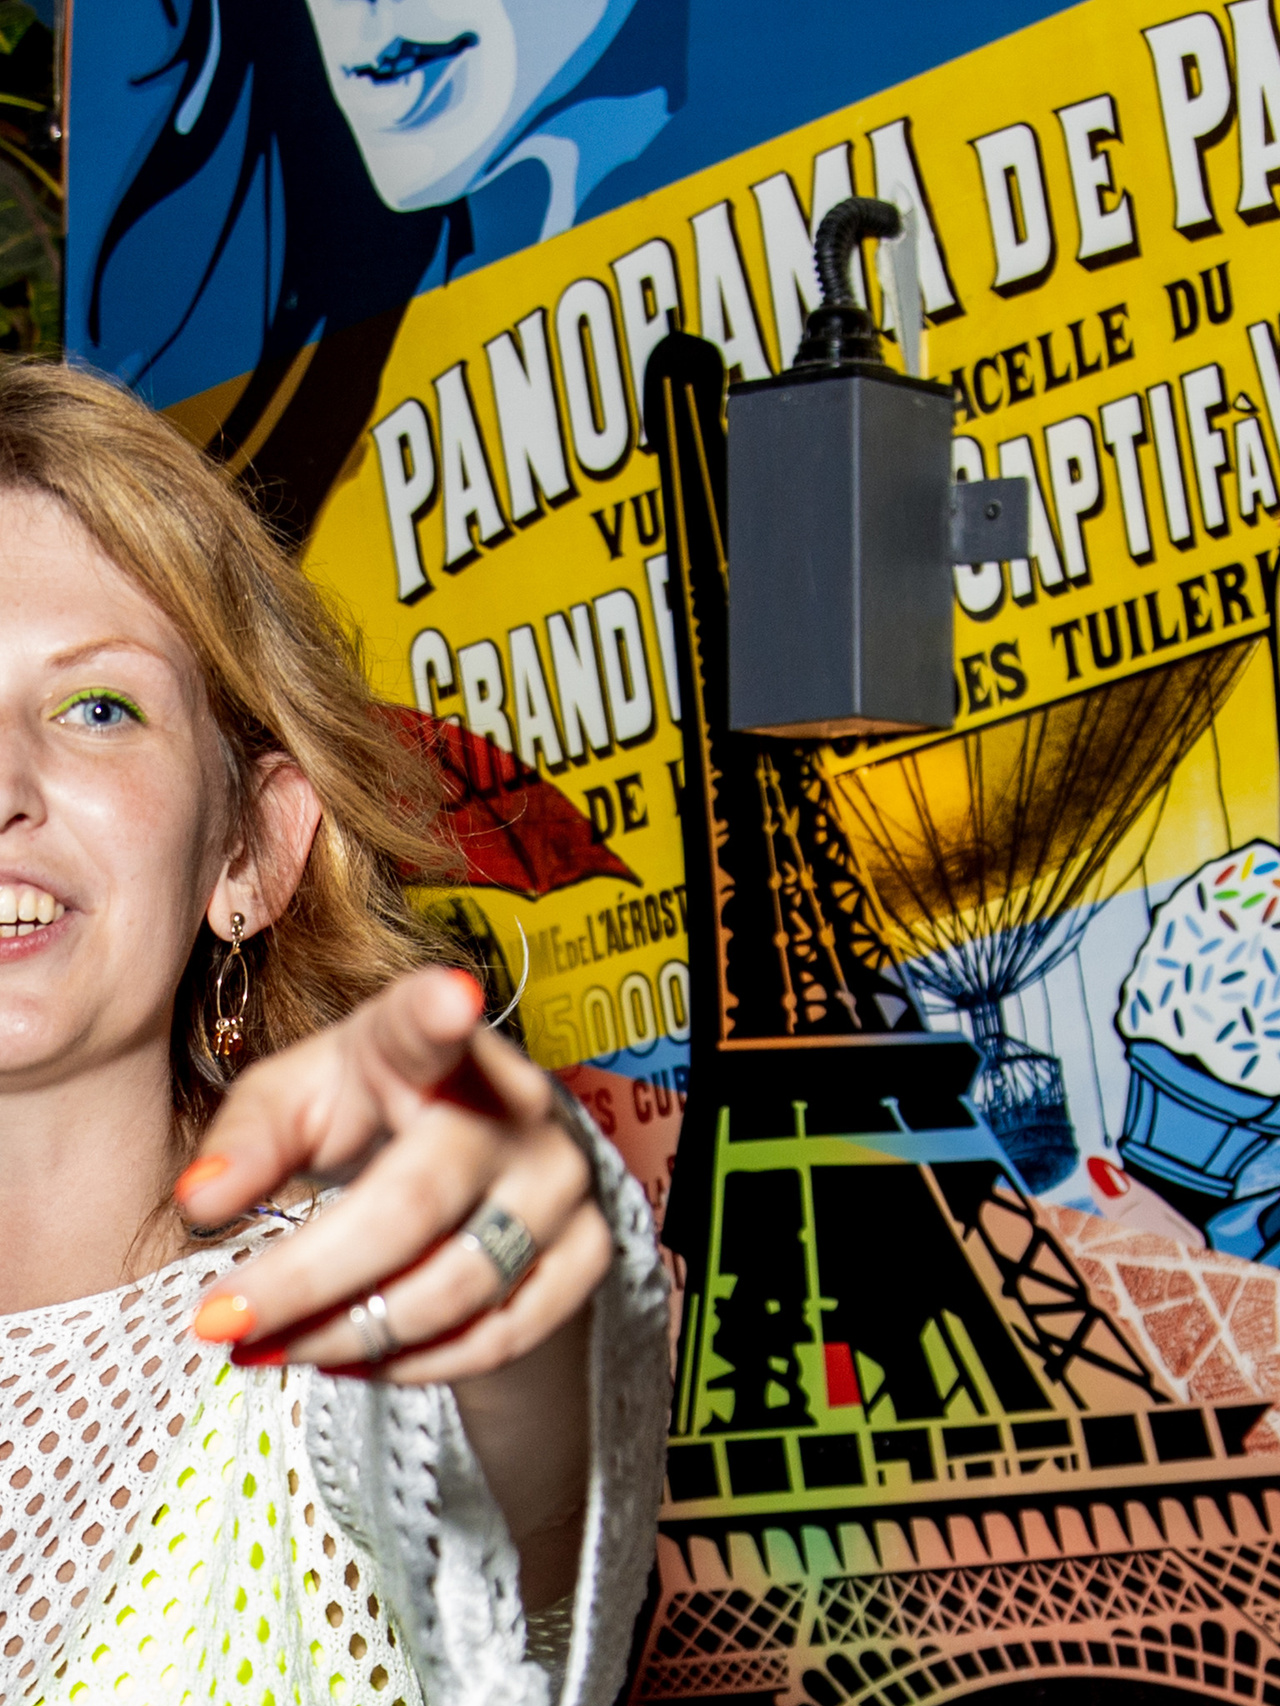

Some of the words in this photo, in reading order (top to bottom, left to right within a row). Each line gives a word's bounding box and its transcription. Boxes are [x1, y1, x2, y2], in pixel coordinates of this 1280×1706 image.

[372, 115, 966, 602] PANORAMA
[967, 92, 1142, 298] DE
[590, 487, 661, 561] VU
[928, 302, 1135, 427] ACELLE
[1163, 260, 1234, 342] DU
[409, 586, 658, 800] GRAND
[582, 772, 650, 845] DE
[954, 639, 1029, 718] ES
